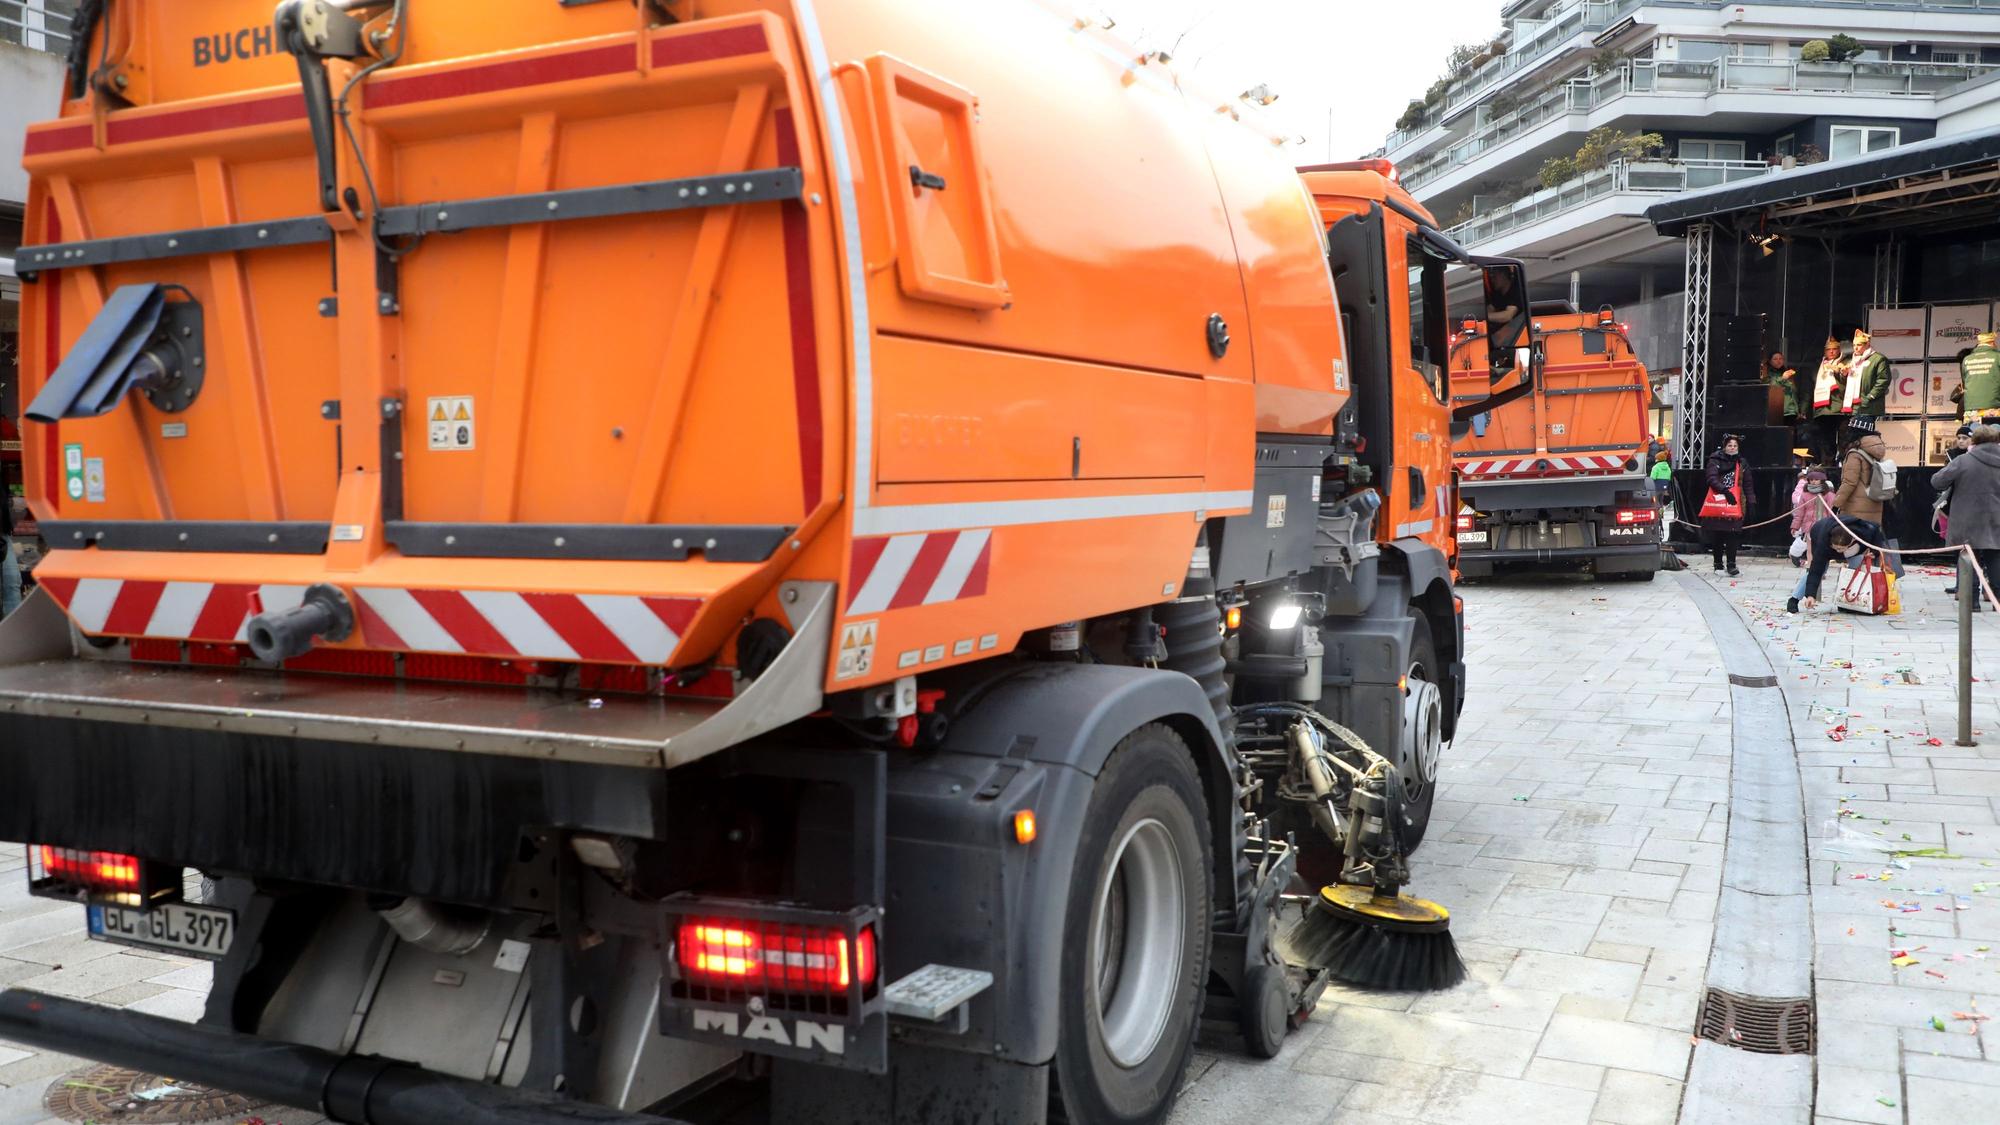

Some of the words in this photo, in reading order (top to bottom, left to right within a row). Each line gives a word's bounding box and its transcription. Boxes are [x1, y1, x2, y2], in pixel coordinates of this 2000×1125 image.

[193, 25, 287, 67] BUCH
[1899, 378, 1914, 396] C
[1609, 527, 1644, 535] MAN
[104, 907, 134, 933] GL
[150, 909, 180, 942] GL
[184, 912, 228, 949] 397
[694, 1009, 845, 1054] MAN
